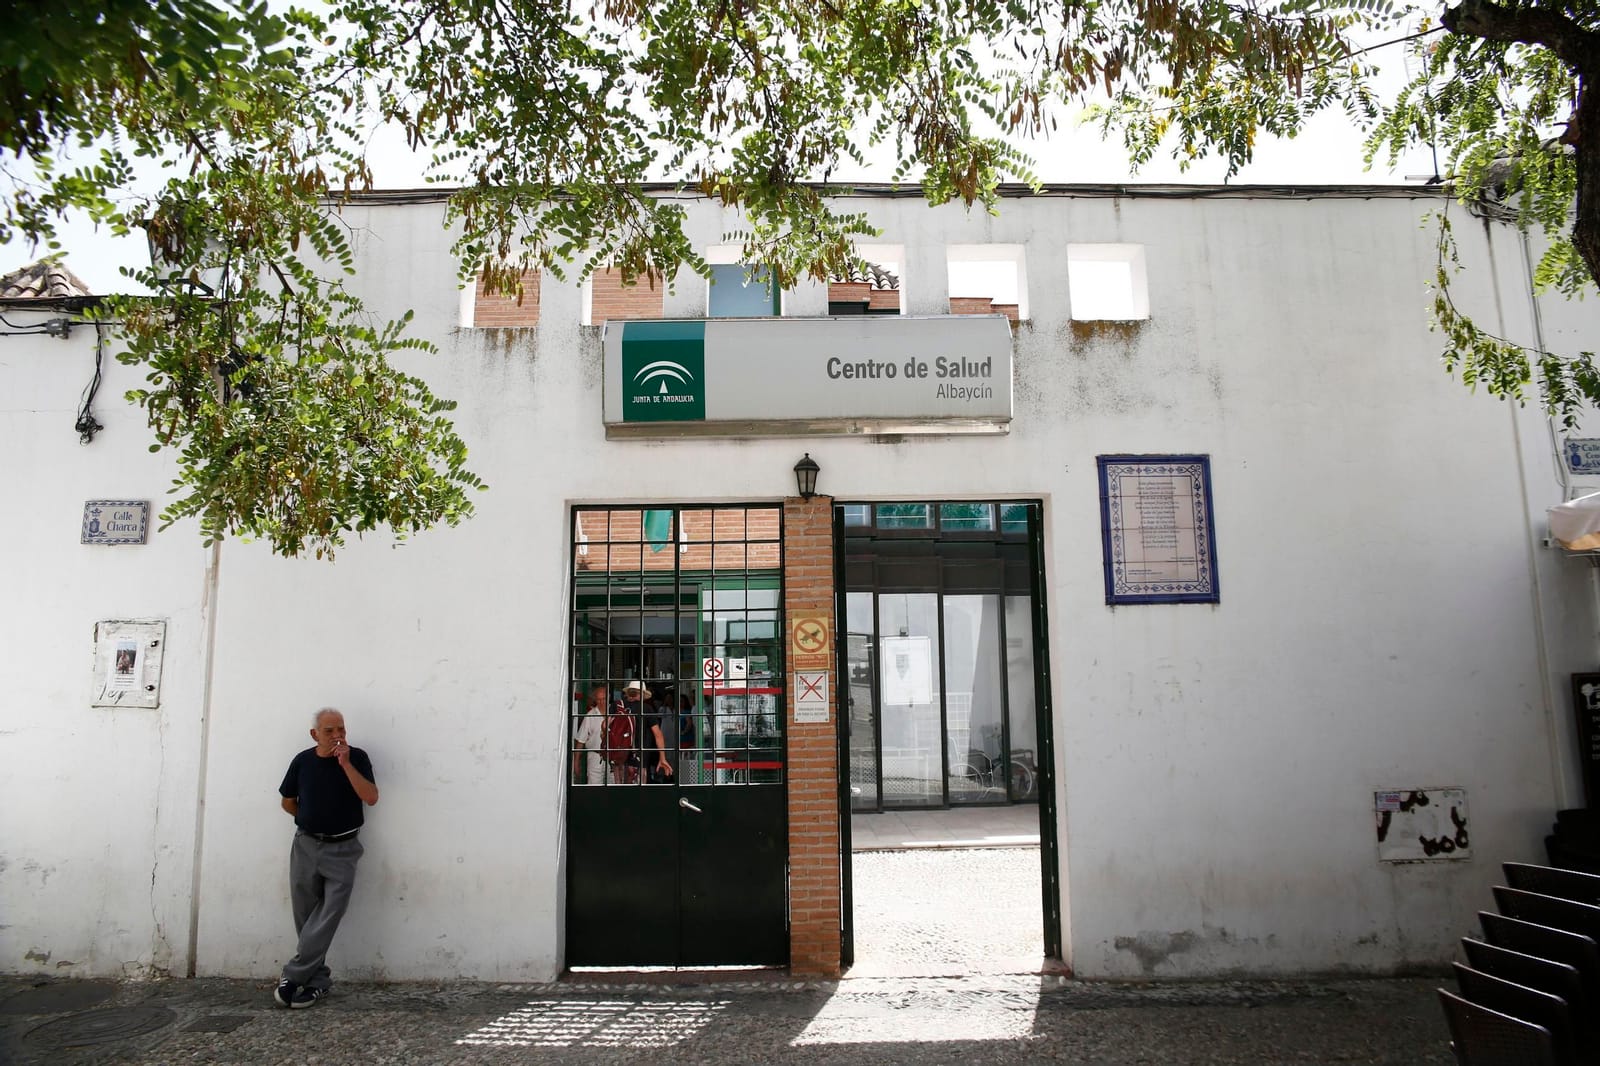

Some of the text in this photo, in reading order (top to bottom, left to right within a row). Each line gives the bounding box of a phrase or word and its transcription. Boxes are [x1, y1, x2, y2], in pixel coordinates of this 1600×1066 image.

[827, 356, 992, 379] Centro de Salud
[935, 382, 993, 403] Albaycín
[632, 394, 695, 404] JUNTA DE ANDALUCIA
[113, 511, 133, 520] Calle
[106, 520, 138, 531] Charca
